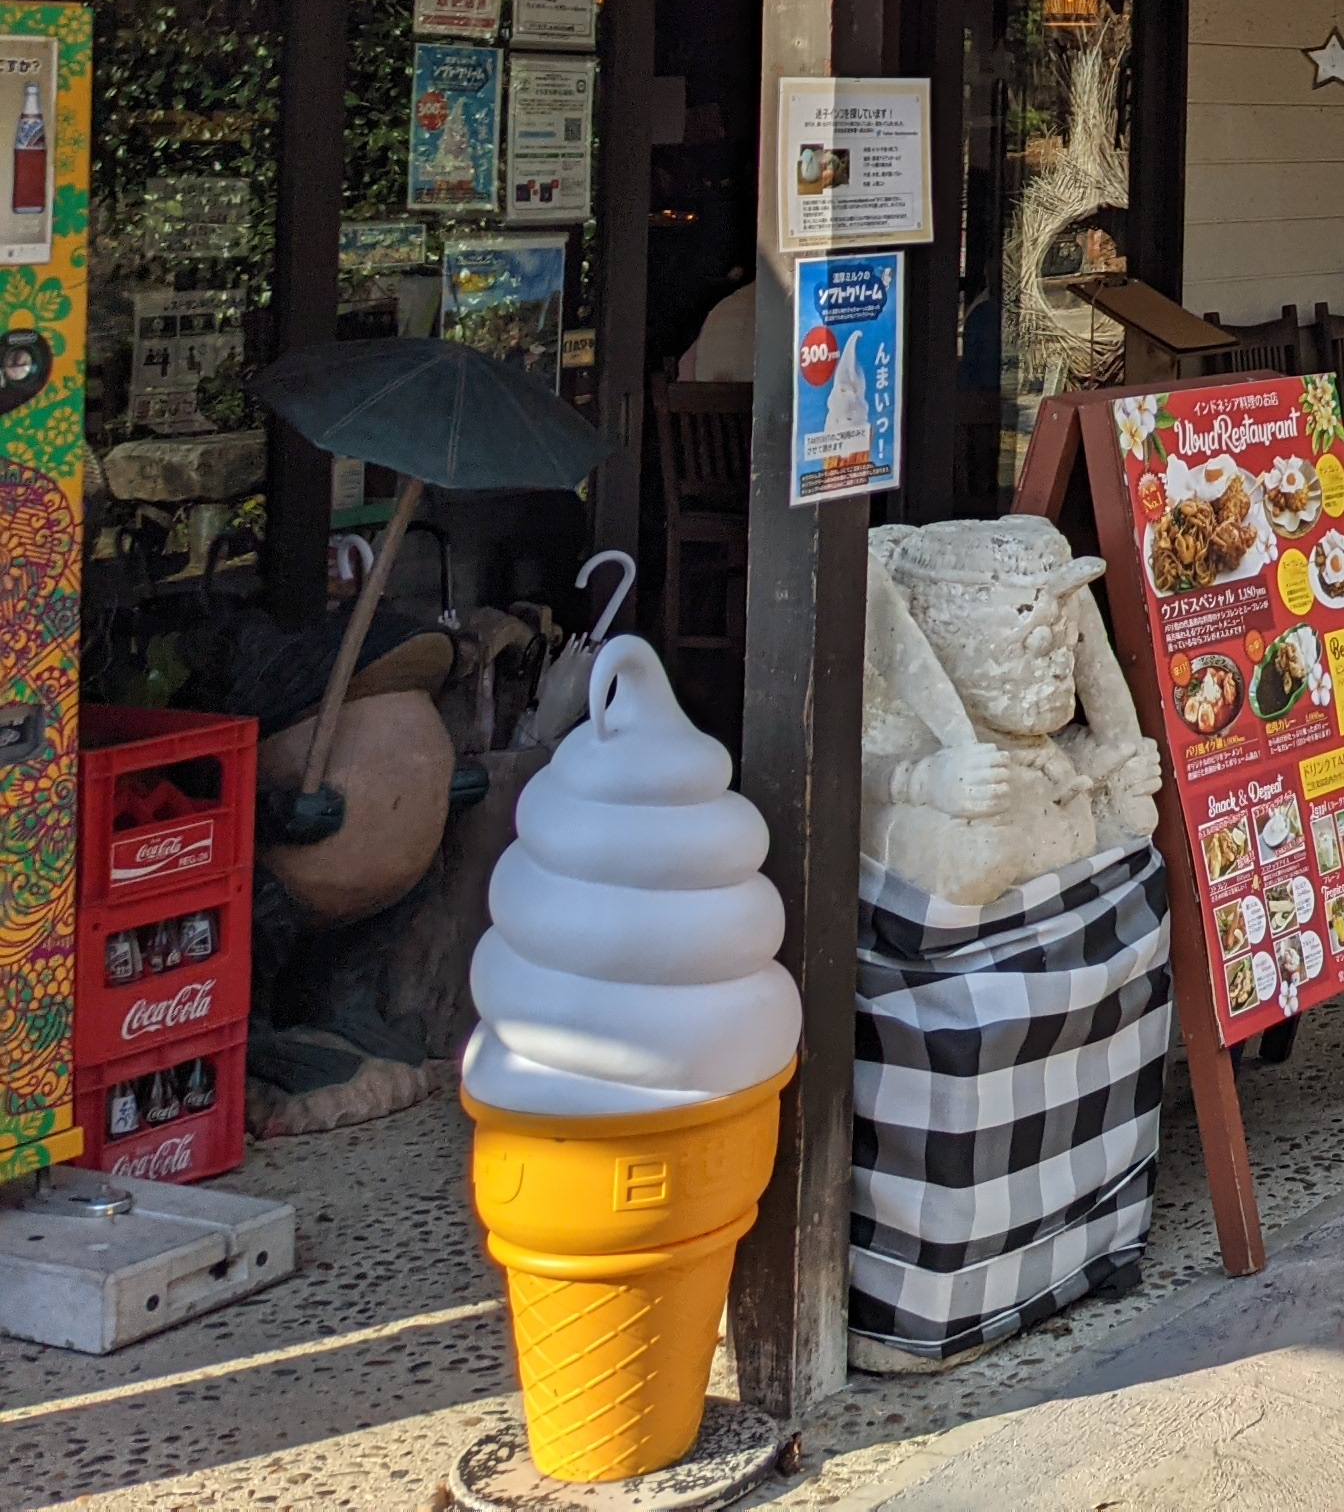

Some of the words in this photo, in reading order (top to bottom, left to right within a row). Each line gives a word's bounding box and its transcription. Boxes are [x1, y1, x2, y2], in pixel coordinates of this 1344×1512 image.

[819, 284, 883, 305] ソフトクリーム
[874, 342, 890, 459] んまいっ！
[1194, 392, 1279, 416] インドネシア料理のお店
[1174, 417, 1220, 456] Ubud
[1218, 407, 1300, 453] Restaurant
[1161, 588, 1235, 620] ウブドスペシャル
[1208, 791, 1239, 817] Snack
[1238, 789, 1248, 807] &
[121, 978, 216, 1041] Coca-Cola
